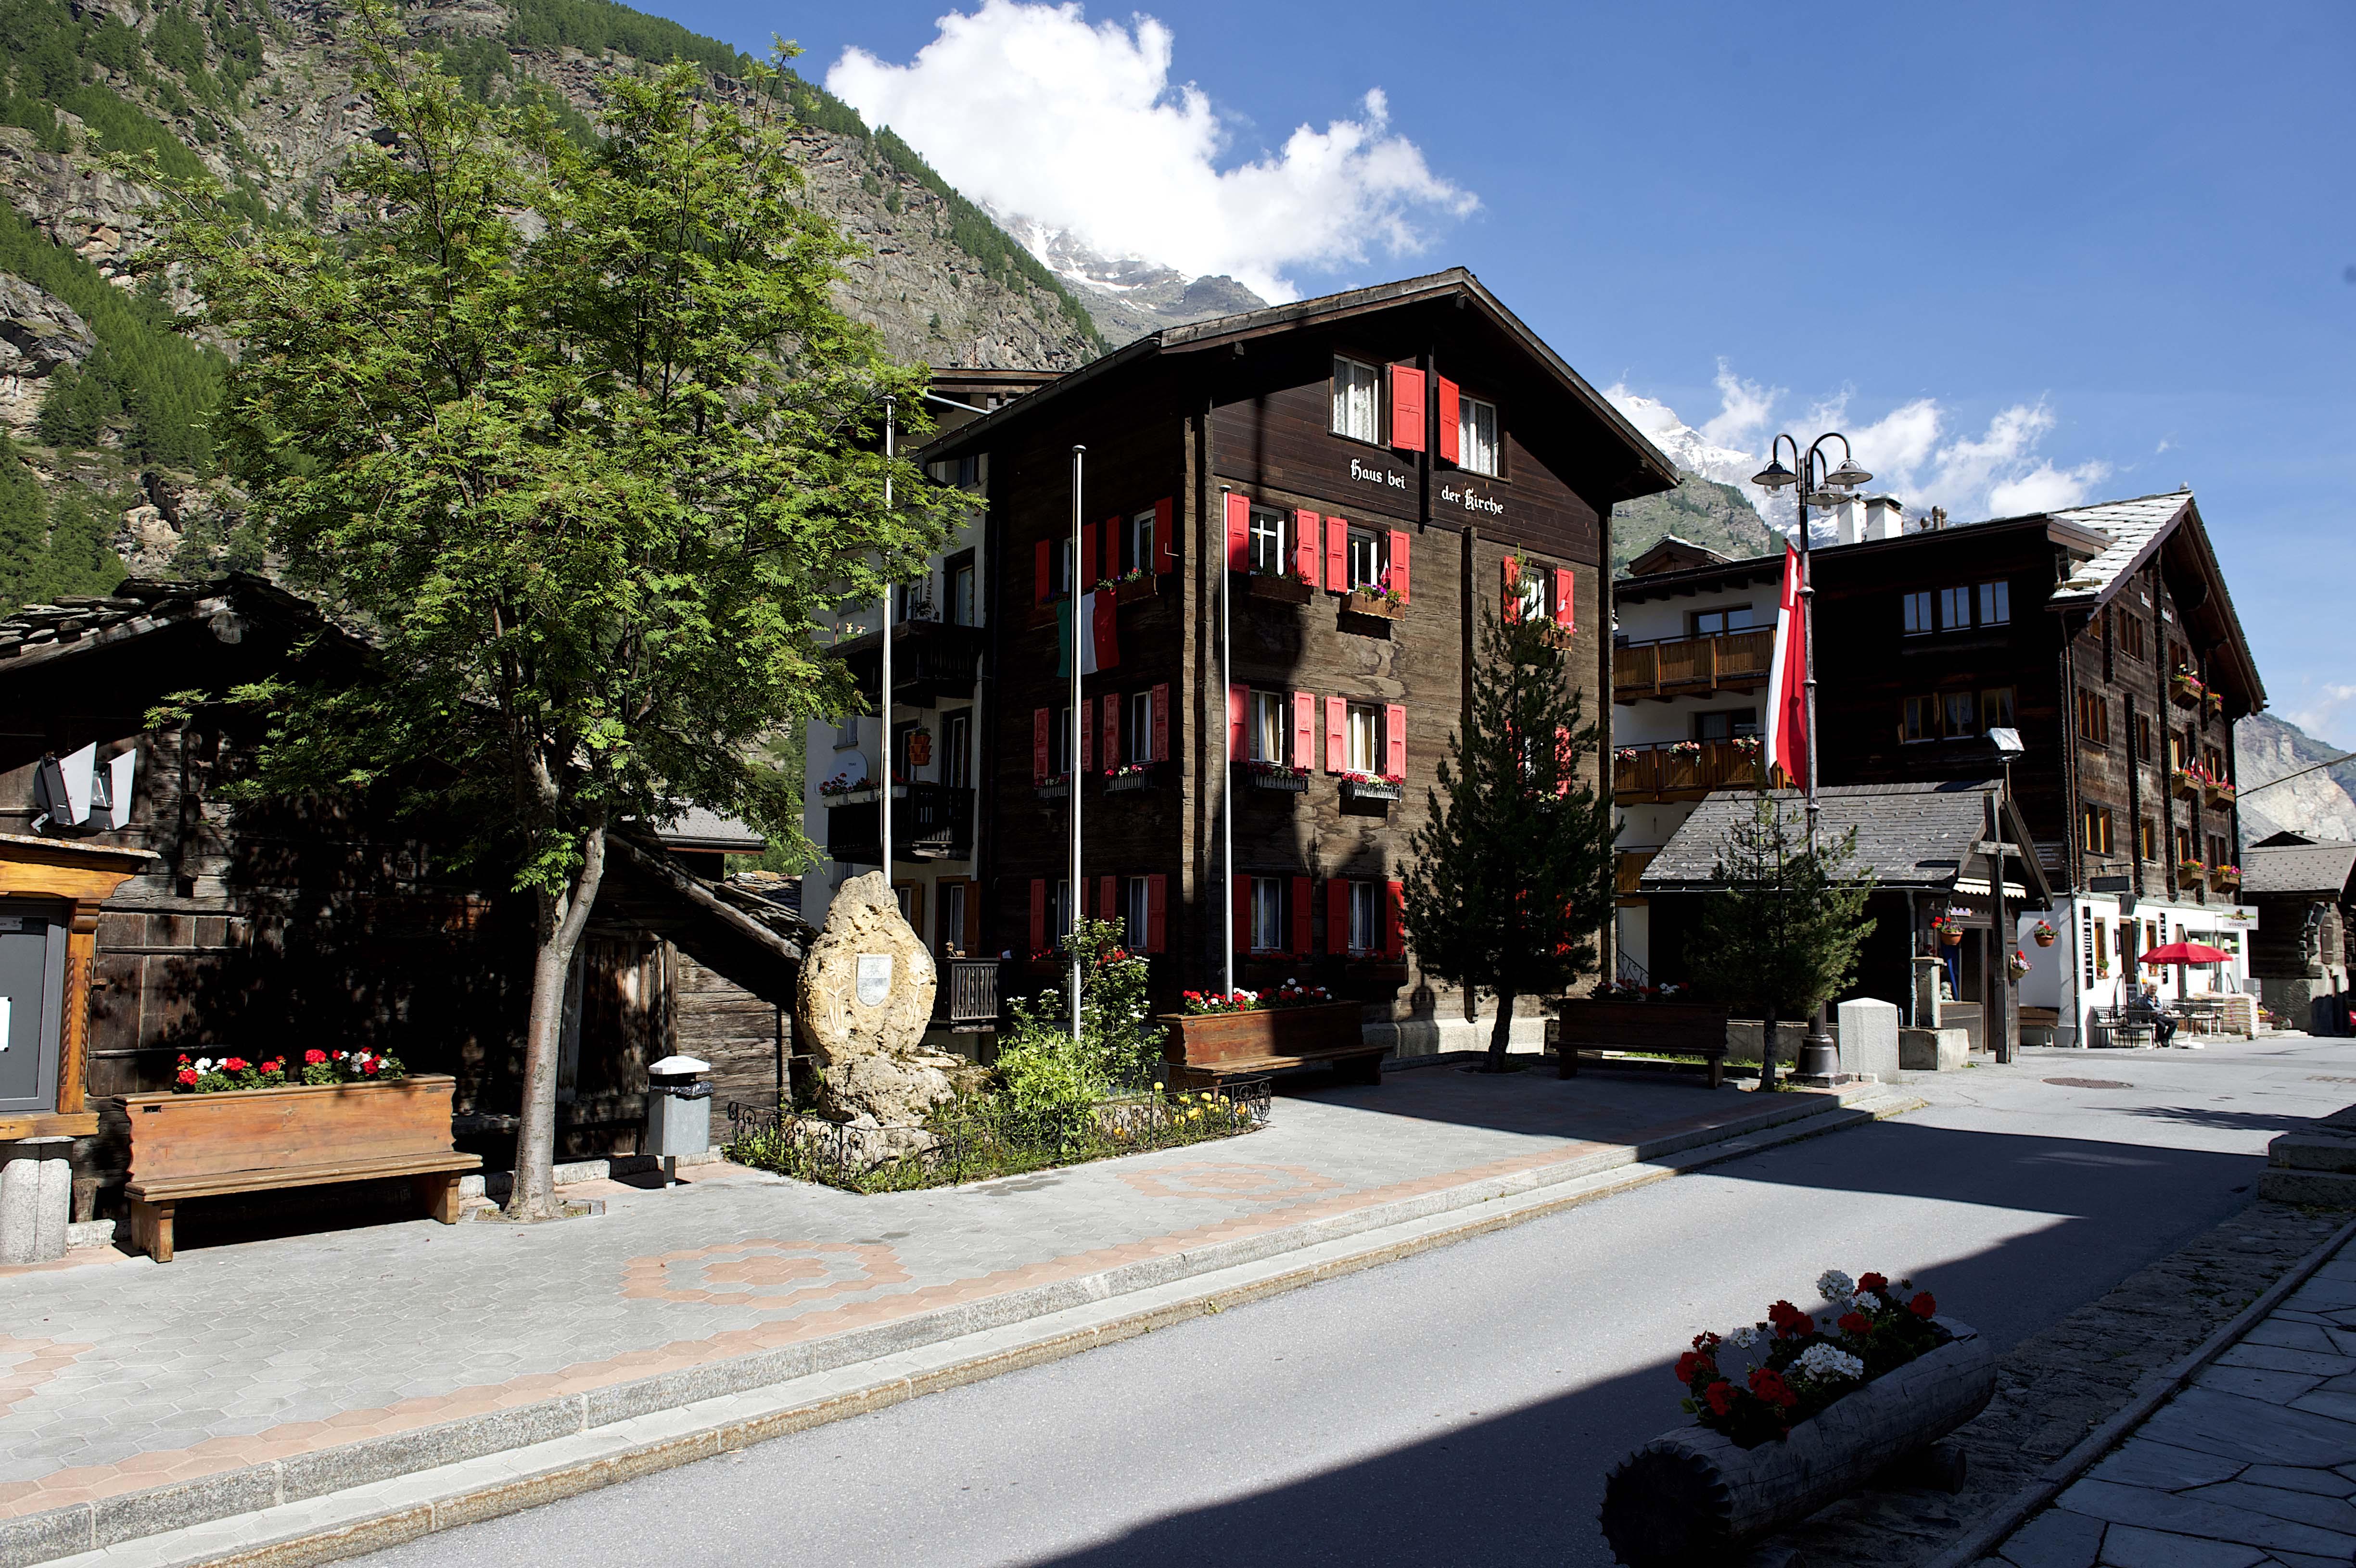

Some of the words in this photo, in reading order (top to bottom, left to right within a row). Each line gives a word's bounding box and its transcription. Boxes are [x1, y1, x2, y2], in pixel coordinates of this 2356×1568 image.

[1350, 458, 1383, 482] Haus
[1388, 469, 1406, 489] bei
[1441, 485, 1461, 503] der
[1464, 487, 1504, 516] Kirche
